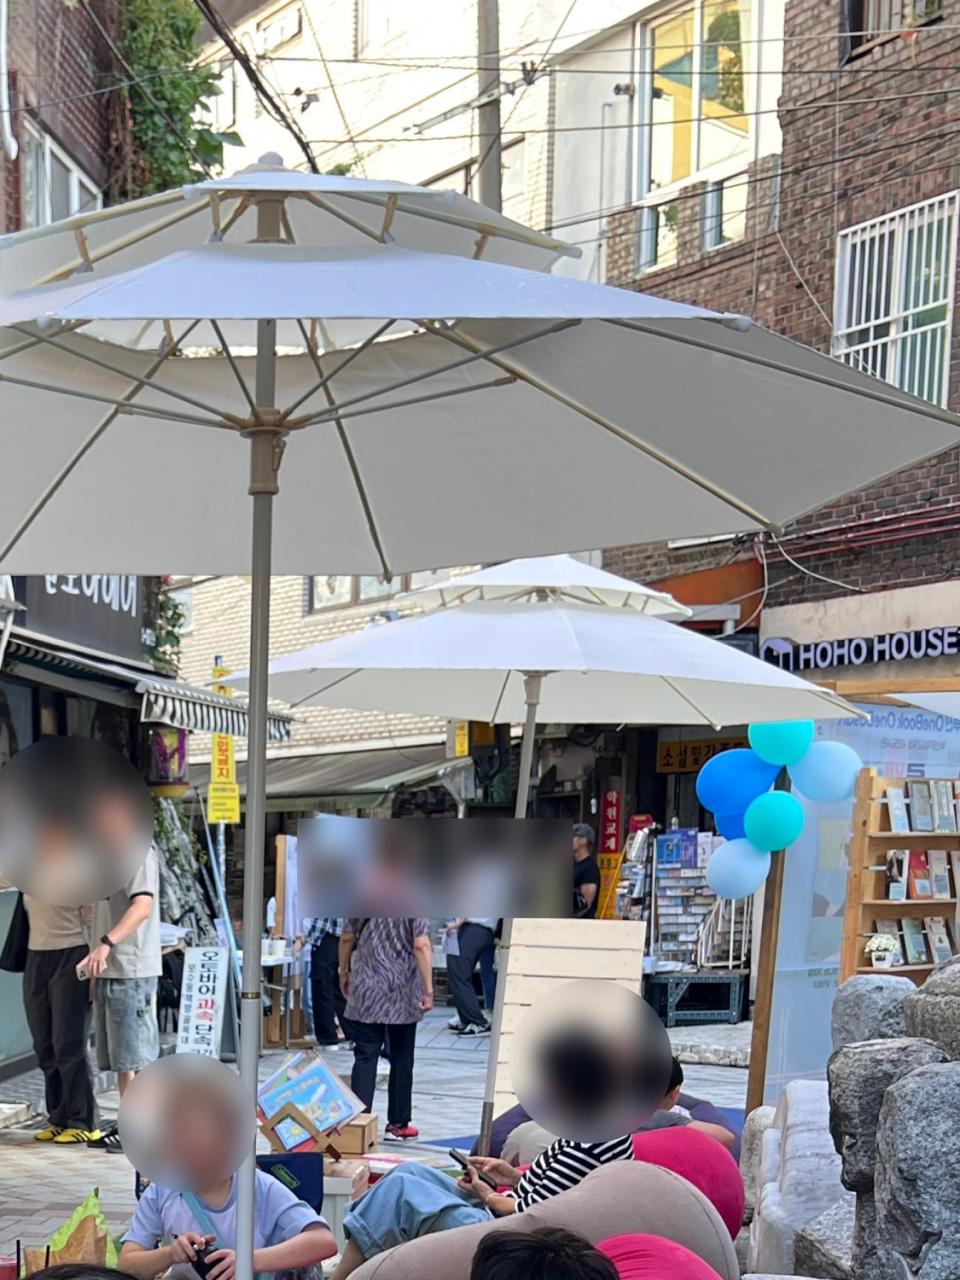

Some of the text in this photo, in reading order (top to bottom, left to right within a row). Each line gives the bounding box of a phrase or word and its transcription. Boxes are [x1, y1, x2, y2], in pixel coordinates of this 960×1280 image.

[799, 626, 958, 670] HOHO HOUSE
[198, 951, 219, 995] 오토바이
